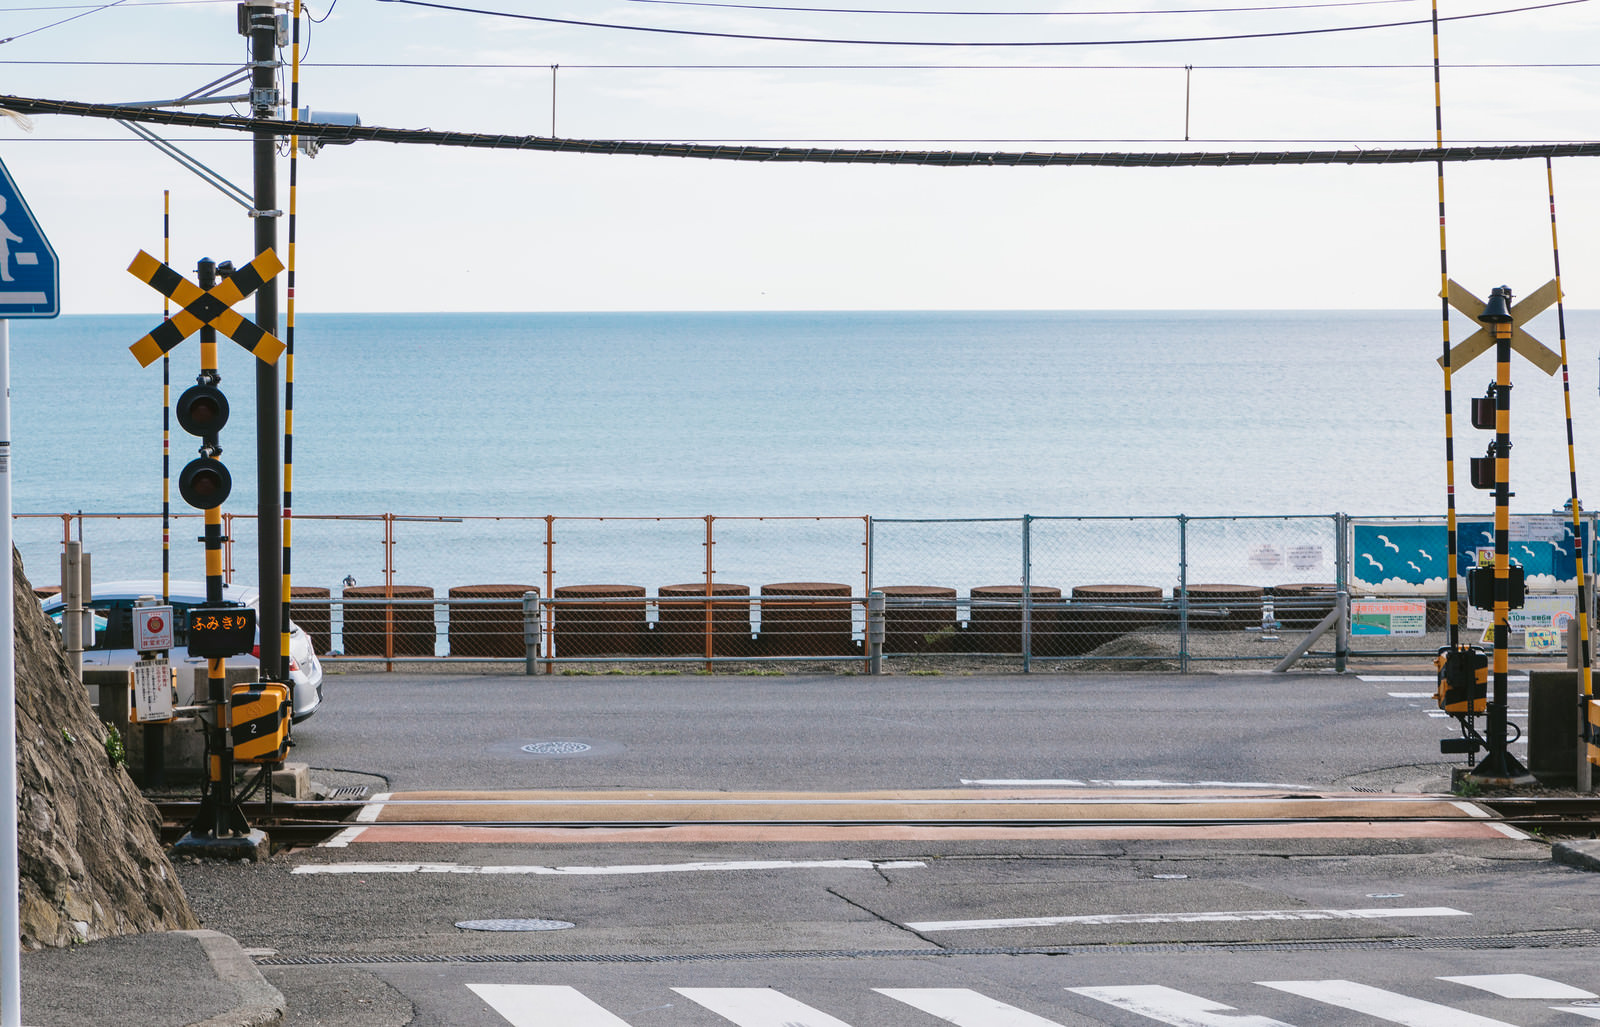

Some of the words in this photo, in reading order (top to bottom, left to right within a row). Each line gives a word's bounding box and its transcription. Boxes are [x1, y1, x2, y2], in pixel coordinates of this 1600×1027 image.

[193, 616, 246, 631] ふみきり
[250, 724, 257, 733] 2
